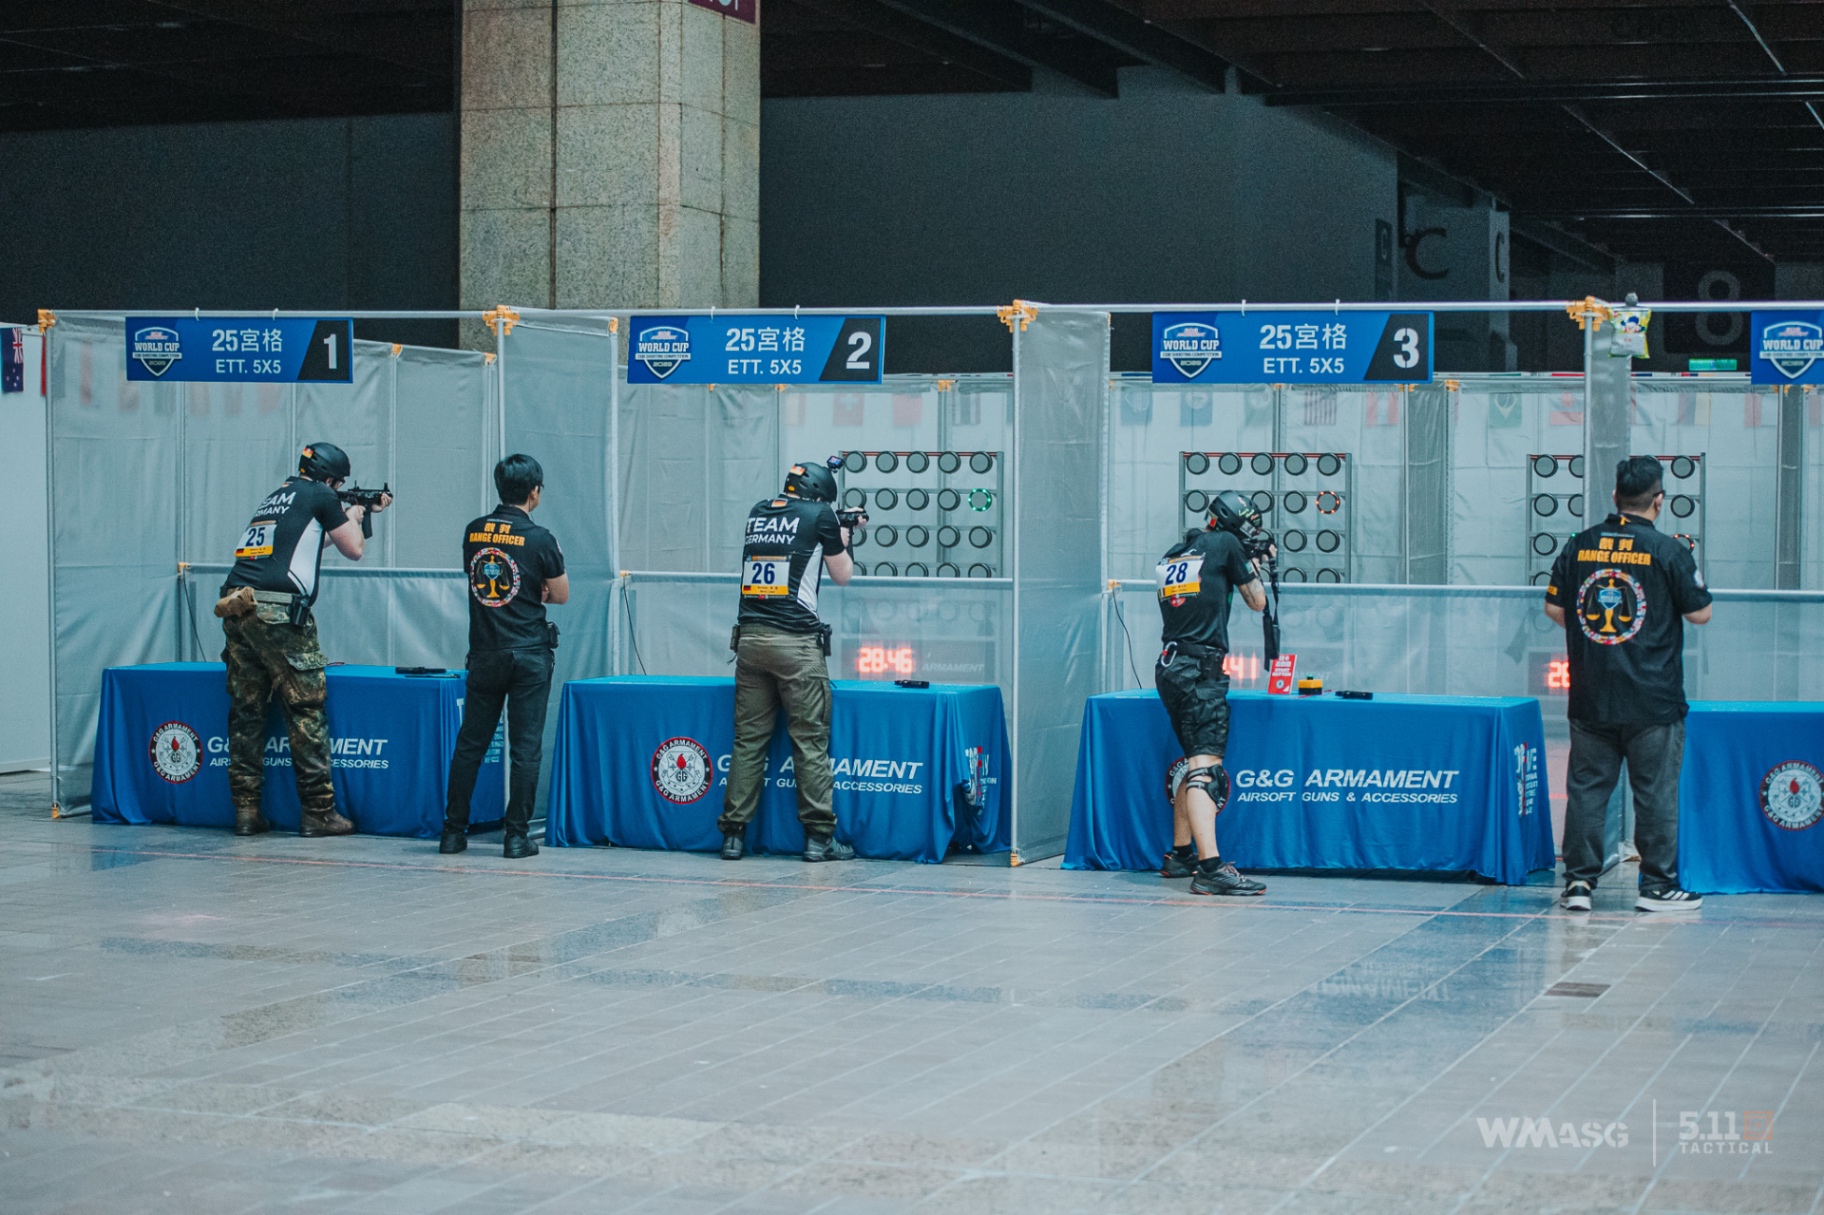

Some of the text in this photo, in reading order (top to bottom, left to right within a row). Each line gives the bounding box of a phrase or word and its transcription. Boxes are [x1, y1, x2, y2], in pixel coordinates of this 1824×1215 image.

[1405, 228, 1450, 280] C
[1495, 231, 1505, 284] C
[1695, 270, 1744, 346] 8
[134, 342, 180, 352] WORLD CUP
[212, 328, 283, 353] 25宮格
[638, 342, 689, 352] WORLD CUP
[725, 327, 806, 352] 25宮格
[1163, 340, 1219, 350] WORLD CUP
[1259, 323, 1347, 350] 25宮格
[1763, 339, 1824, 351] WORLD CUP
[323, 333, 338, 370] 1
[846, 331, 872, 369] 2
[1393, 327, 1419, 369] 3
[215, 359, 282, 374] ETT. 5X5
[728, 359, 802, 375] ETT. 5X5
[1263, 357, 1345, 374] ETT. 5X5
[747, 517, 800, 534] TEAM
[245, 526, 266, 547] 25
[469, 532, 525, 547] RANGE OFFICER
[1577, 549, 1652, 566] RANGE OFFICER
[751, 562, 776, 585] 26
[1165, 562, 1189, 586] 28
[264, 736, 389, 756] ARMENT
[669, 739, 708, 760] ARMAMENT
[262, 757, 293, 767] GUNS
[779, 756, 924, 780] AAMENT
[833, 781, 923, 795] ACCESSORIES
[1235, 768, 1460, 789] G&G ARMAMENT
[668, 781, 710, 803] ARMAMENT
[1237, 791, 1458, 804] AIRSOFT GUNS & ACCESSORIES
